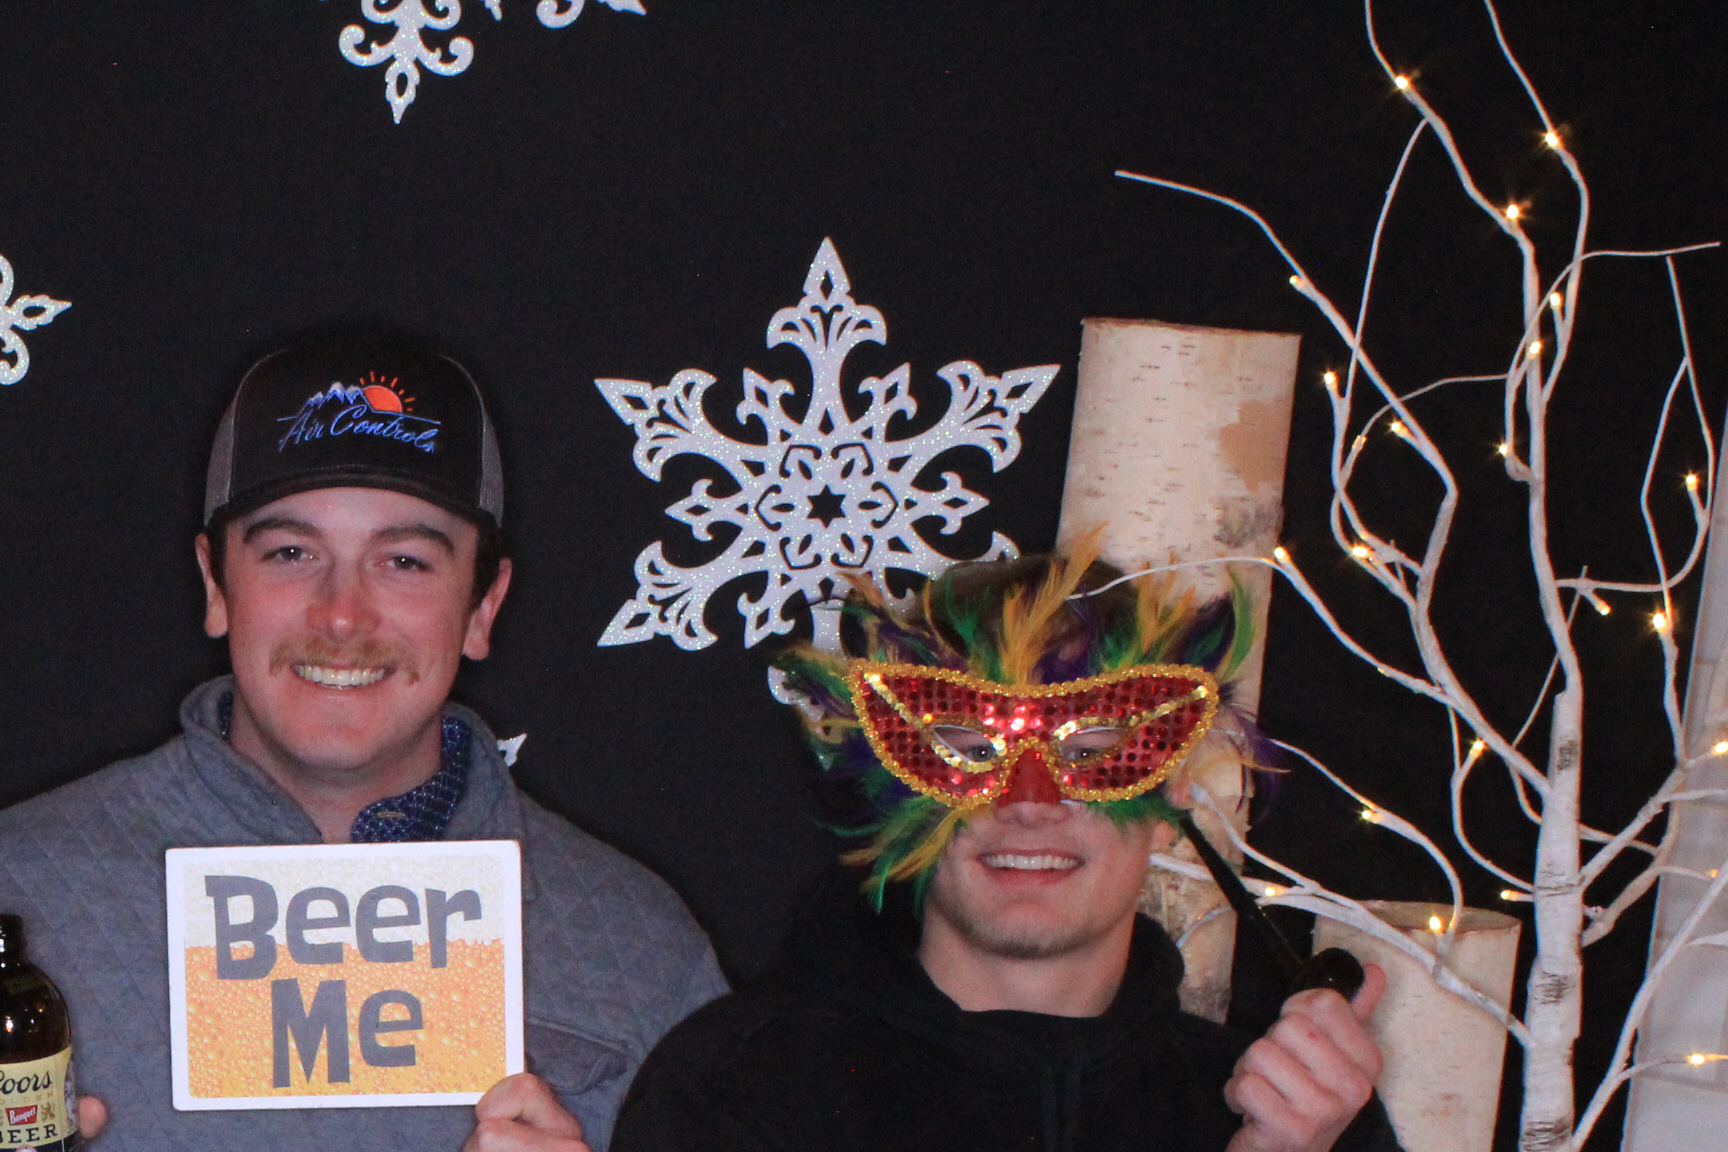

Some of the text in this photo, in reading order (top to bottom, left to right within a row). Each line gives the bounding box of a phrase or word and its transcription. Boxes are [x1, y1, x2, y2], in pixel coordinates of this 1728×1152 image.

[278, 405, 439, 453] Air Controls
[204, 875, 482, 980] Beer
[271, 978, 424, 1089] Me
[9, 1107, 36, 1125] Banquet
